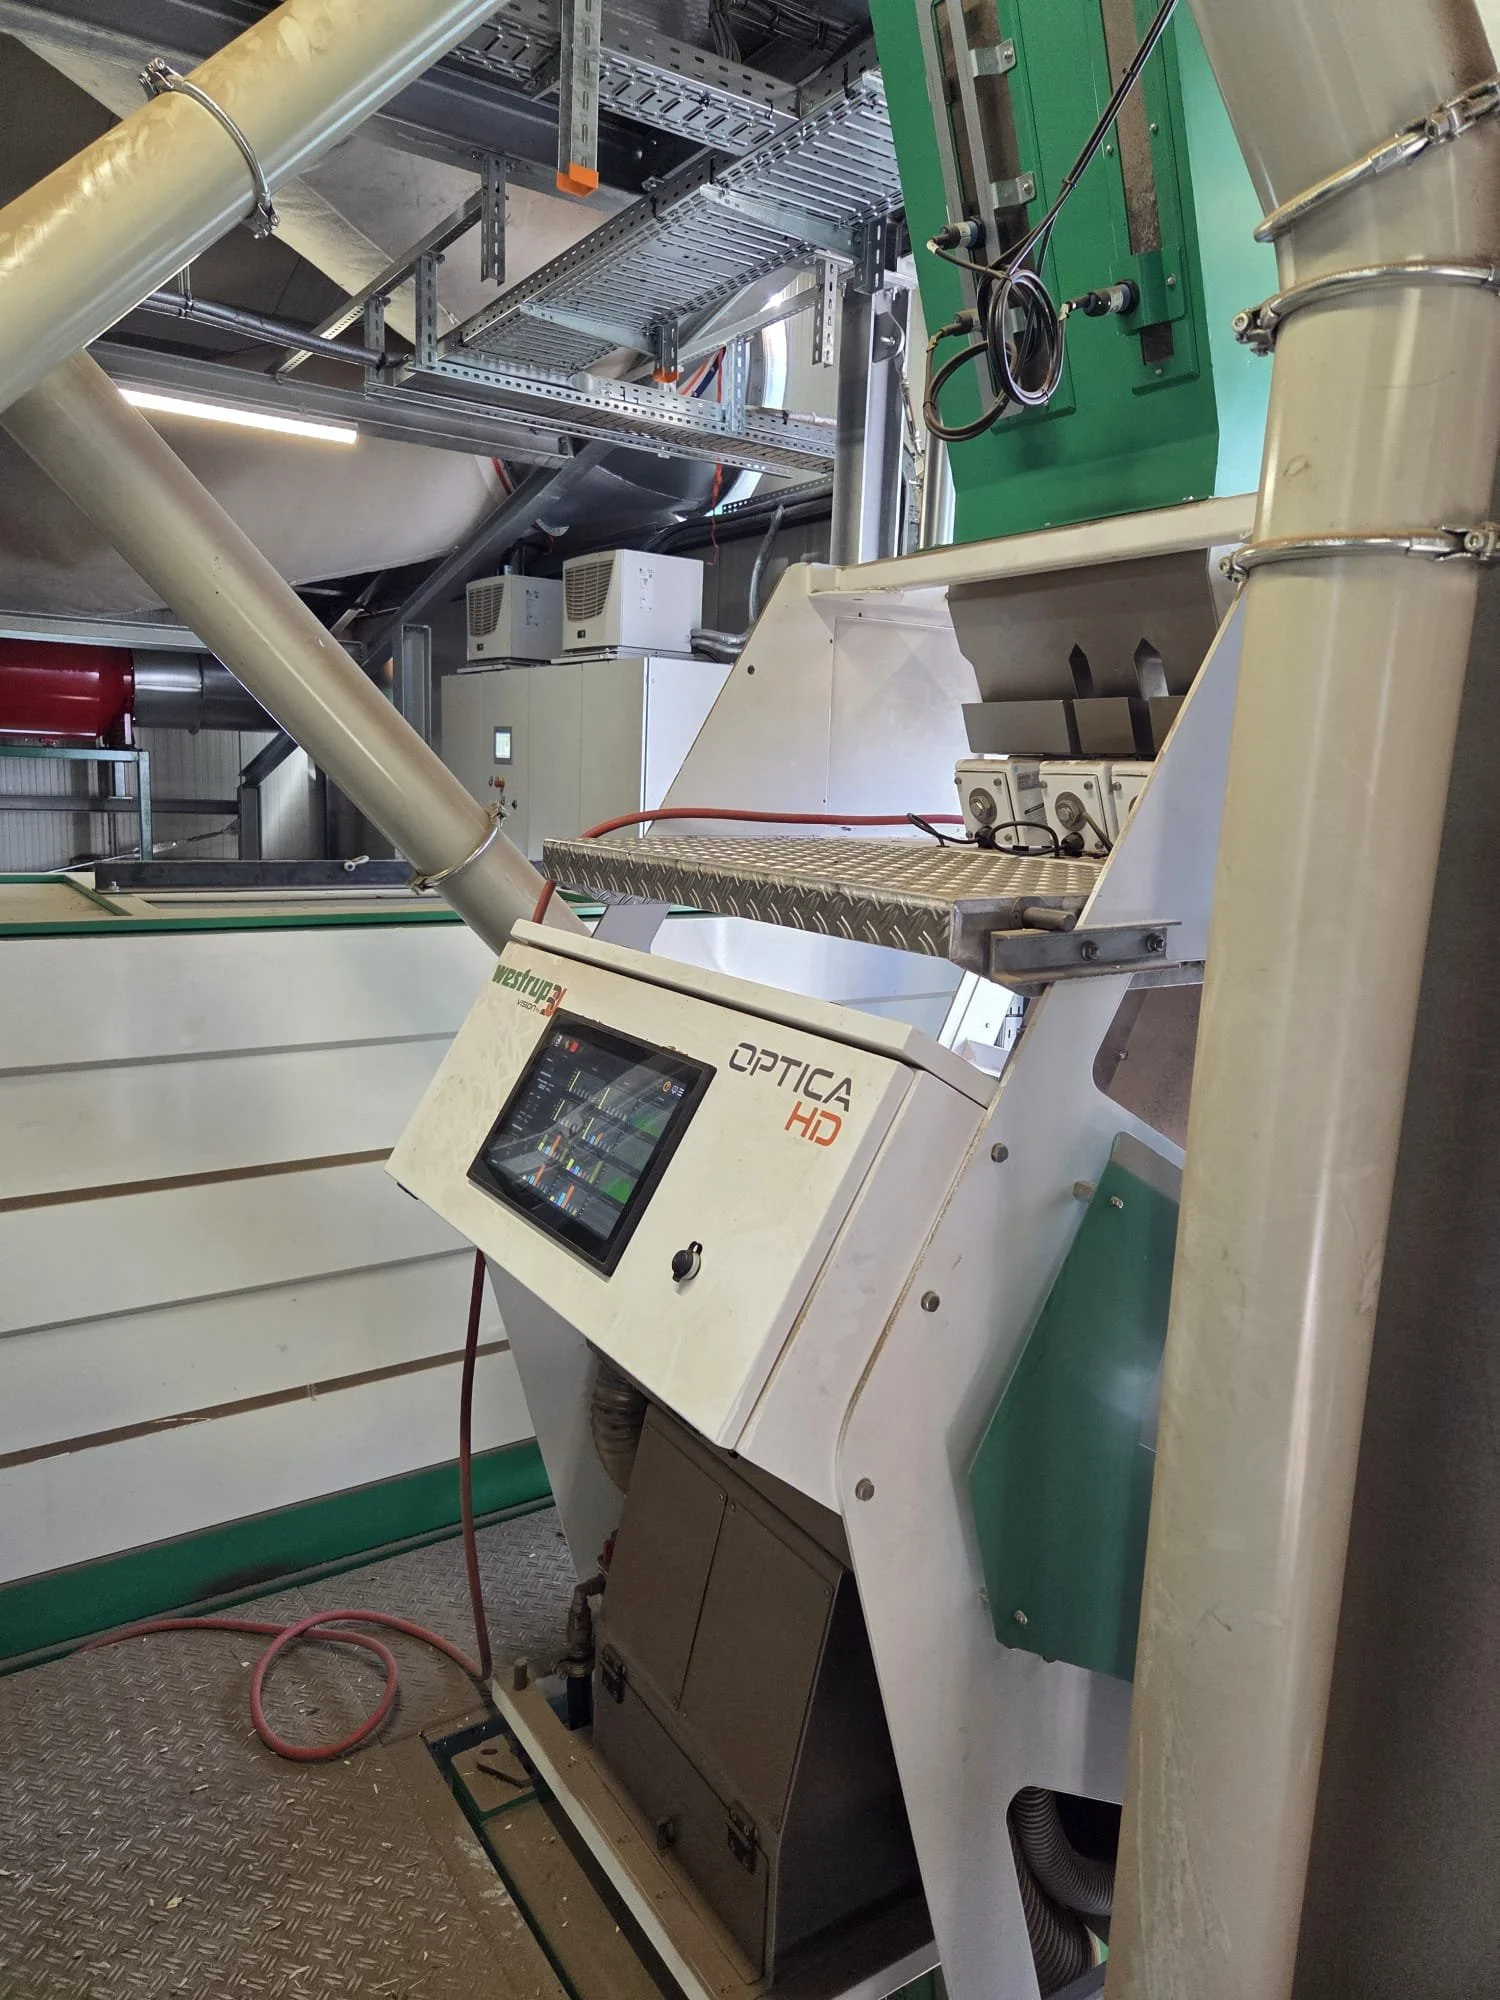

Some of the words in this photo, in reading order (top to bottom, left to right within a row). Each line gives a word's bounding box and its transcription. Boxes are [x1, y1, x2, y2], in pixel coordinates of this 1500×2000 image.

[492, 964, 553, 1004] westrup
[728, 1042, 852, 1112] OPTICA
[784, 1101, 842, 1146] HD
